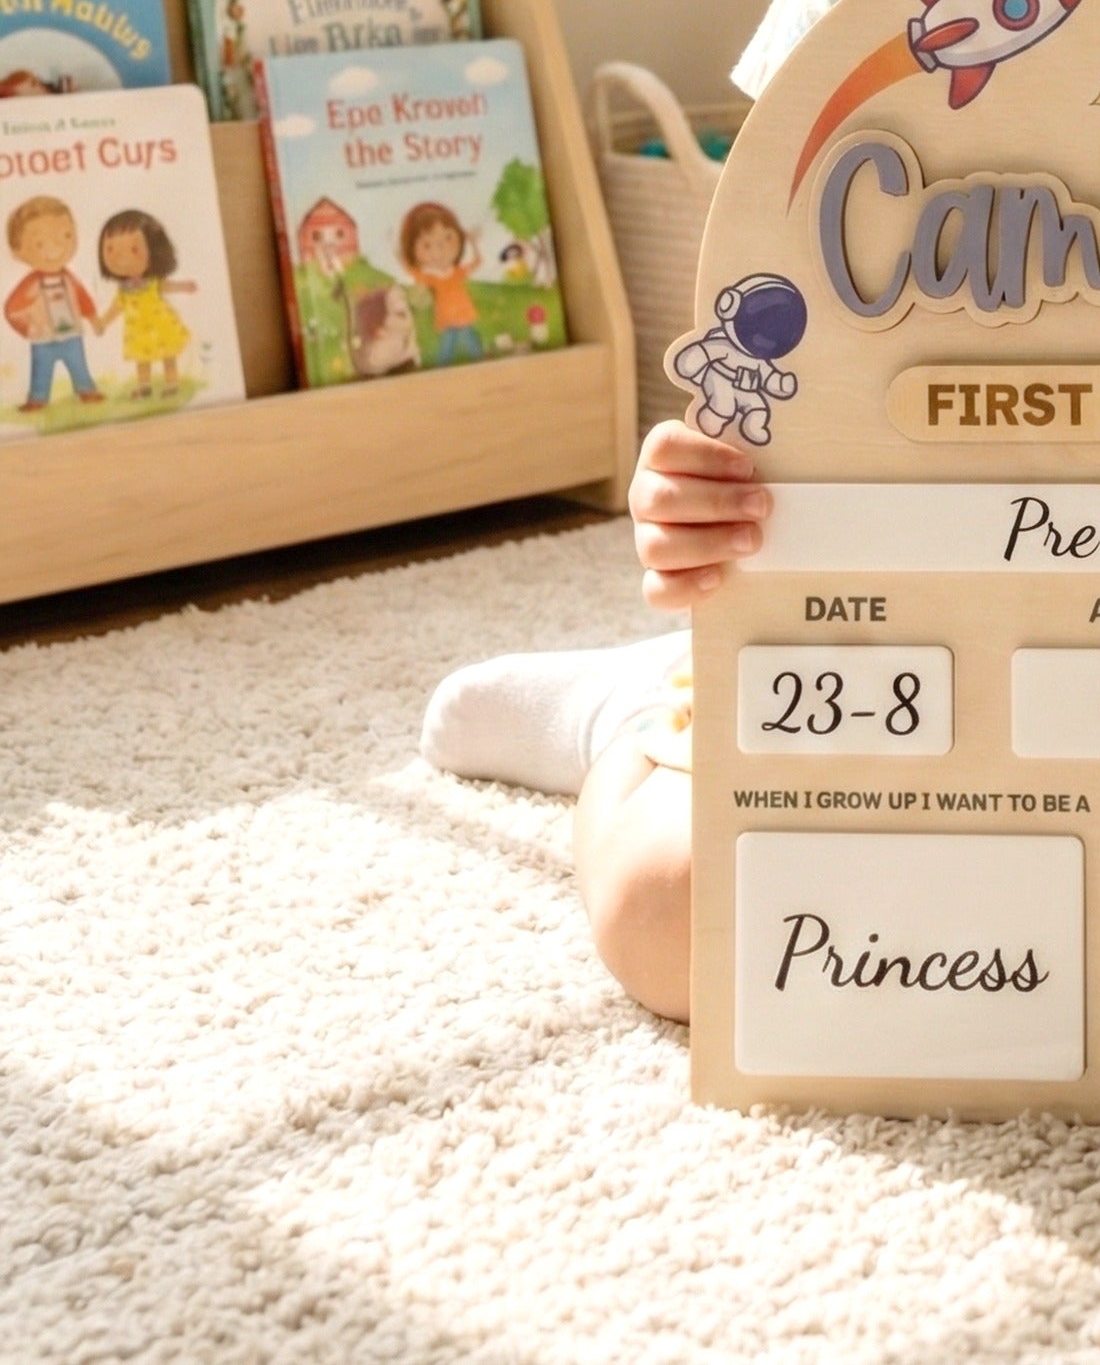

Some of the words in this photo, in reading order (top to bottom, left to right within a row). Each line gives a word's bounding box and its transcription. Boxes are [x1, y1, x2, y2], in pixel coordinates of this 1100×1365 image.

[344, 137, 394, 169] the
[402, 131, 483, 166] Story
[927, 383, 1093, 427] FIRST
[1003, 496, 1100, 563] Pre
[804, 596, 887, 622] DATE
[761, 671, 921, 736] 23-8
[733, 790, 798, 809] WHEN
[804, 790, 812, 809] I
[816, 791, 883, 810] GROW
[888, 792, 917, 810] UP
[921, 792, 931, 811] I
[936, 792, 1004, 812] WANT
[1006, 793, 1037, 813] TO
[1042, 794, 1071, 813] BE
[1075, 794, 1091, 813] A
[774, 913, 1050, 993] Princess
